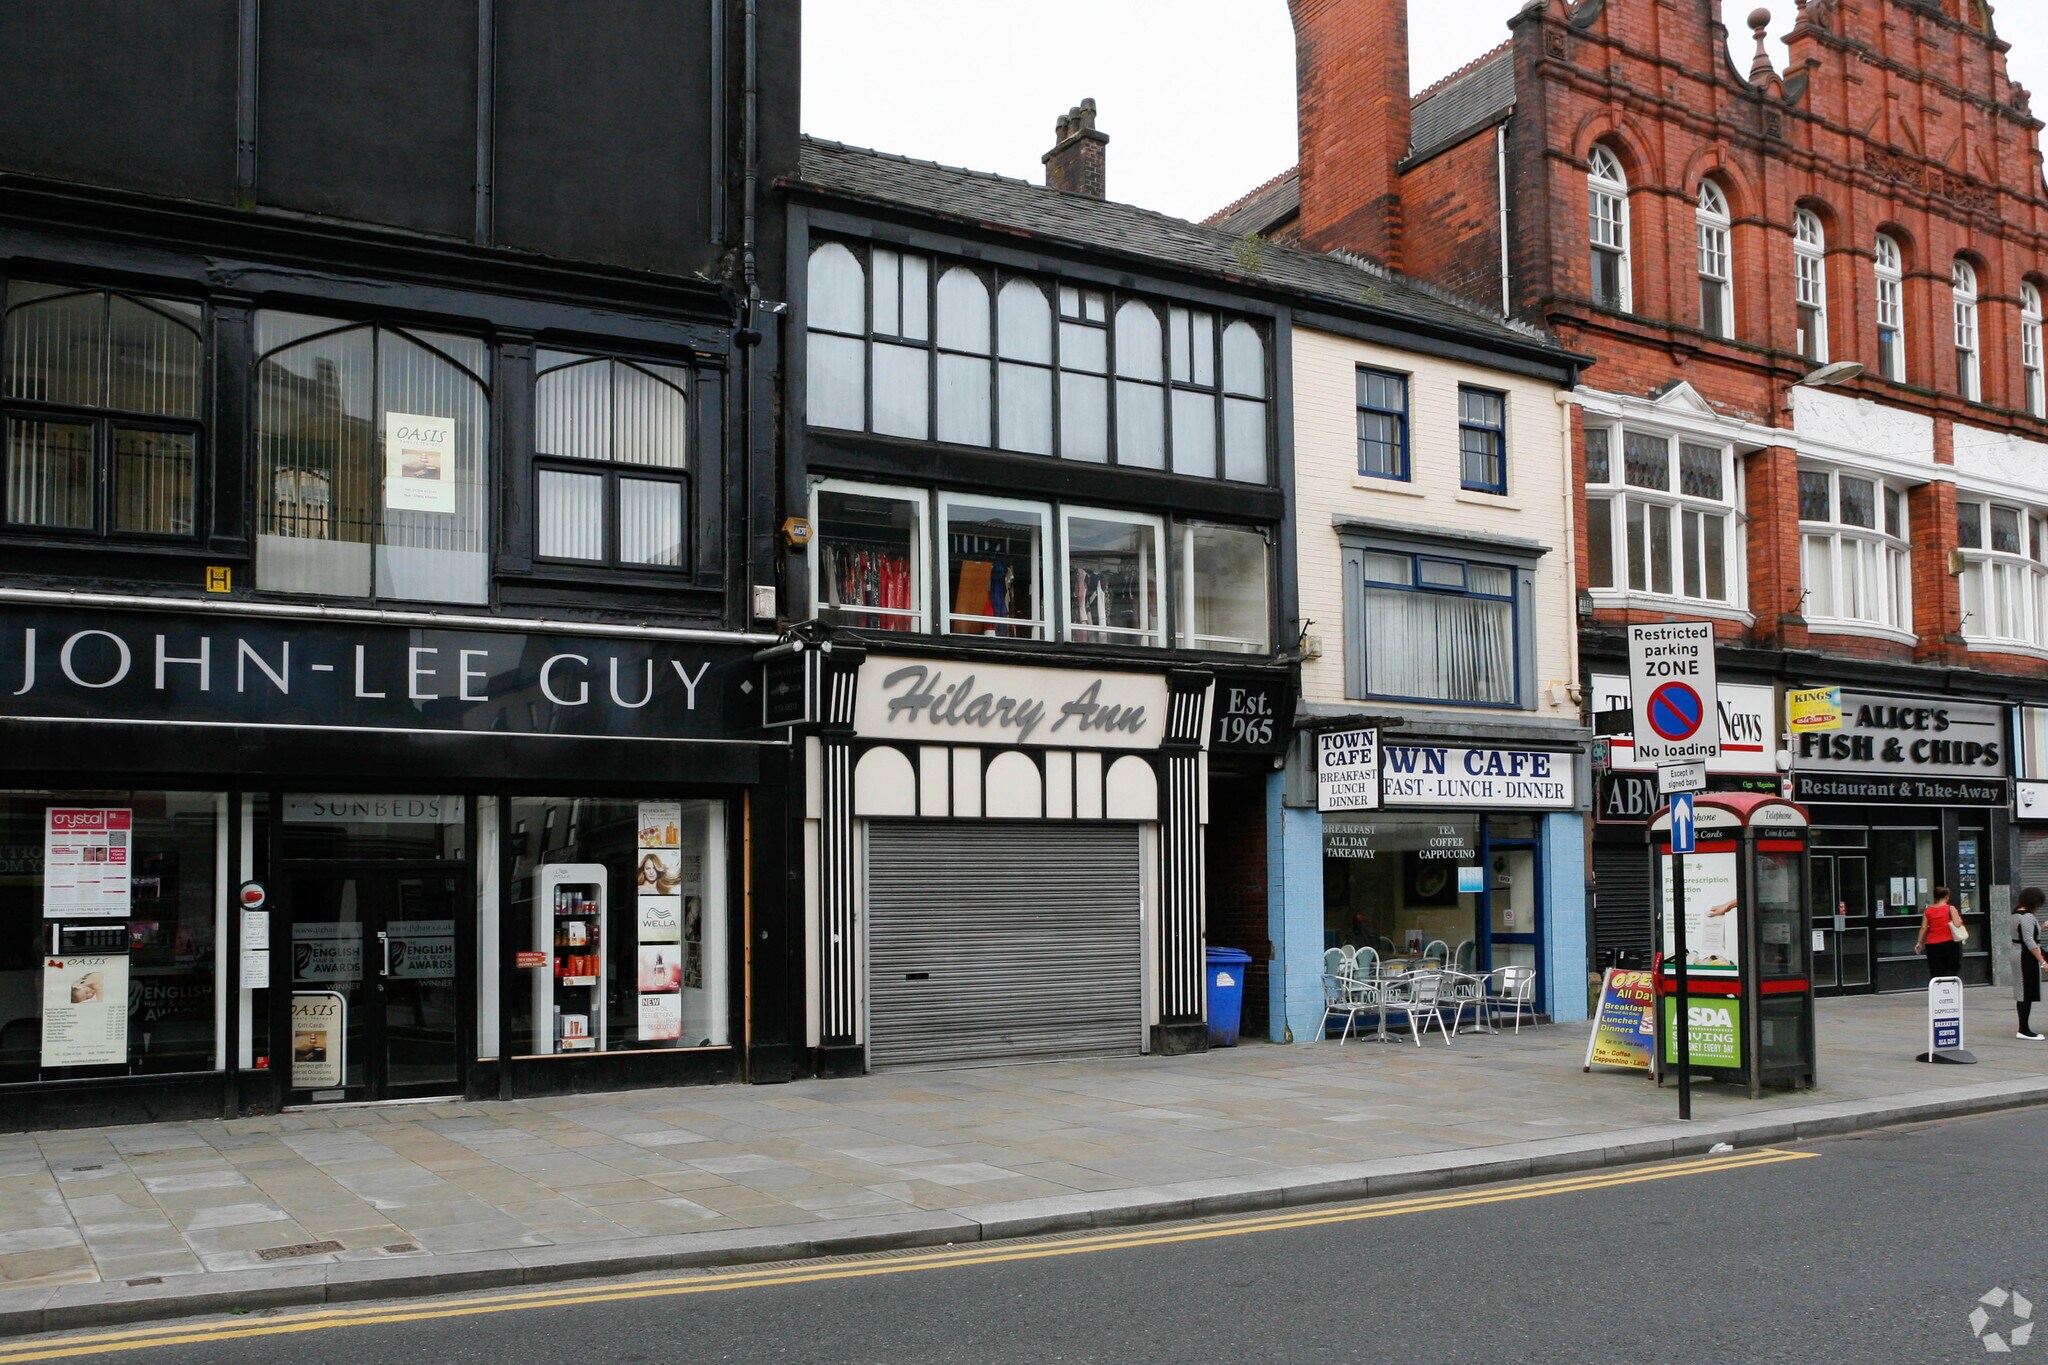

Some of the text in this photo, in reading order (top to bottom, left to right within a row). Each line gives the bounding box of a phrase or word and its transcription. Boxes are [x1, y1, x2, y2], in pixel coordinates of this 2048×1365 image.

[397, 427, 447, 443] OASIS
[1634, 626, 1708, 641] Restricted
[1645, 644, 1698, 658] parking
[13, 628, 711, 710] JOHN-LEE GUY
[1646, 660, 1699, 677] ZONE
[1227, 688, 1272, 715] Est.
[1794, 691, 1832, 703] KINGS
[883, 665, 1146, 744] Hilary Ann
[1856, 704, 1950, 732] ALICE'S
[1218, 716, 1274, 744] 1965
[1321, 731, 1375, 750] TOWN
[1639, 743, 1716, 758] No loading
[1800, 732, 2000, 766] FISH & CHIPS
[1325, 749, 1371, 767] CAFE
[1464, 750, 1551, 778] CAFE
[1320, 769, 1377, 783] BREAKFAST
[1670, 768, 1695, 779] Except in
[1331, 783, 1365, 795] LUNCH
[1437, 779, 1493, 798] LUNCH
[1505, 782, 1565, 800] DINNER
[1668, 778, 1698, 789] signed bays
[1801, 778, 1999, 801] Restaurant & Take-Away
[1329, 795, 1368, 807] DINNER
[314, 800, 439, 818] SUNBEDS
[1765, 810, 1792, 821] Telephone
[1323, 825, 1376, 834] BREAKFAST
[1437, 825, 1455, 835] TEA
[1700, 830, 1723, 838] Cards
[1330, 837, 1369, 847] ALL DAY
[1429, 837, 1464, 847] COFFEE
[1326, 848, 1376, 859] TAKEAWAY
[1418, 849, 1475, 859] CAPPUCCINO
[313, 948, 361, 957] ENGLISH
[408, 945, 452, 954] ENGLISH
[67, 958, 108, 966] OASIS
[314, 963, 361, 973] AWARDS
[408, 960, 453, 970] AWARDS
[1611, 972, 1653, 989] OPE
[1616, 988, 1632, 999] All
[642, 998, 660, 1006] NEW
[1601, 1015, 1638, 1025] Lunches
[1600, 1024, 1634, 1034] Dinners
[1611, 1049, 1631, 1058] Coffee
